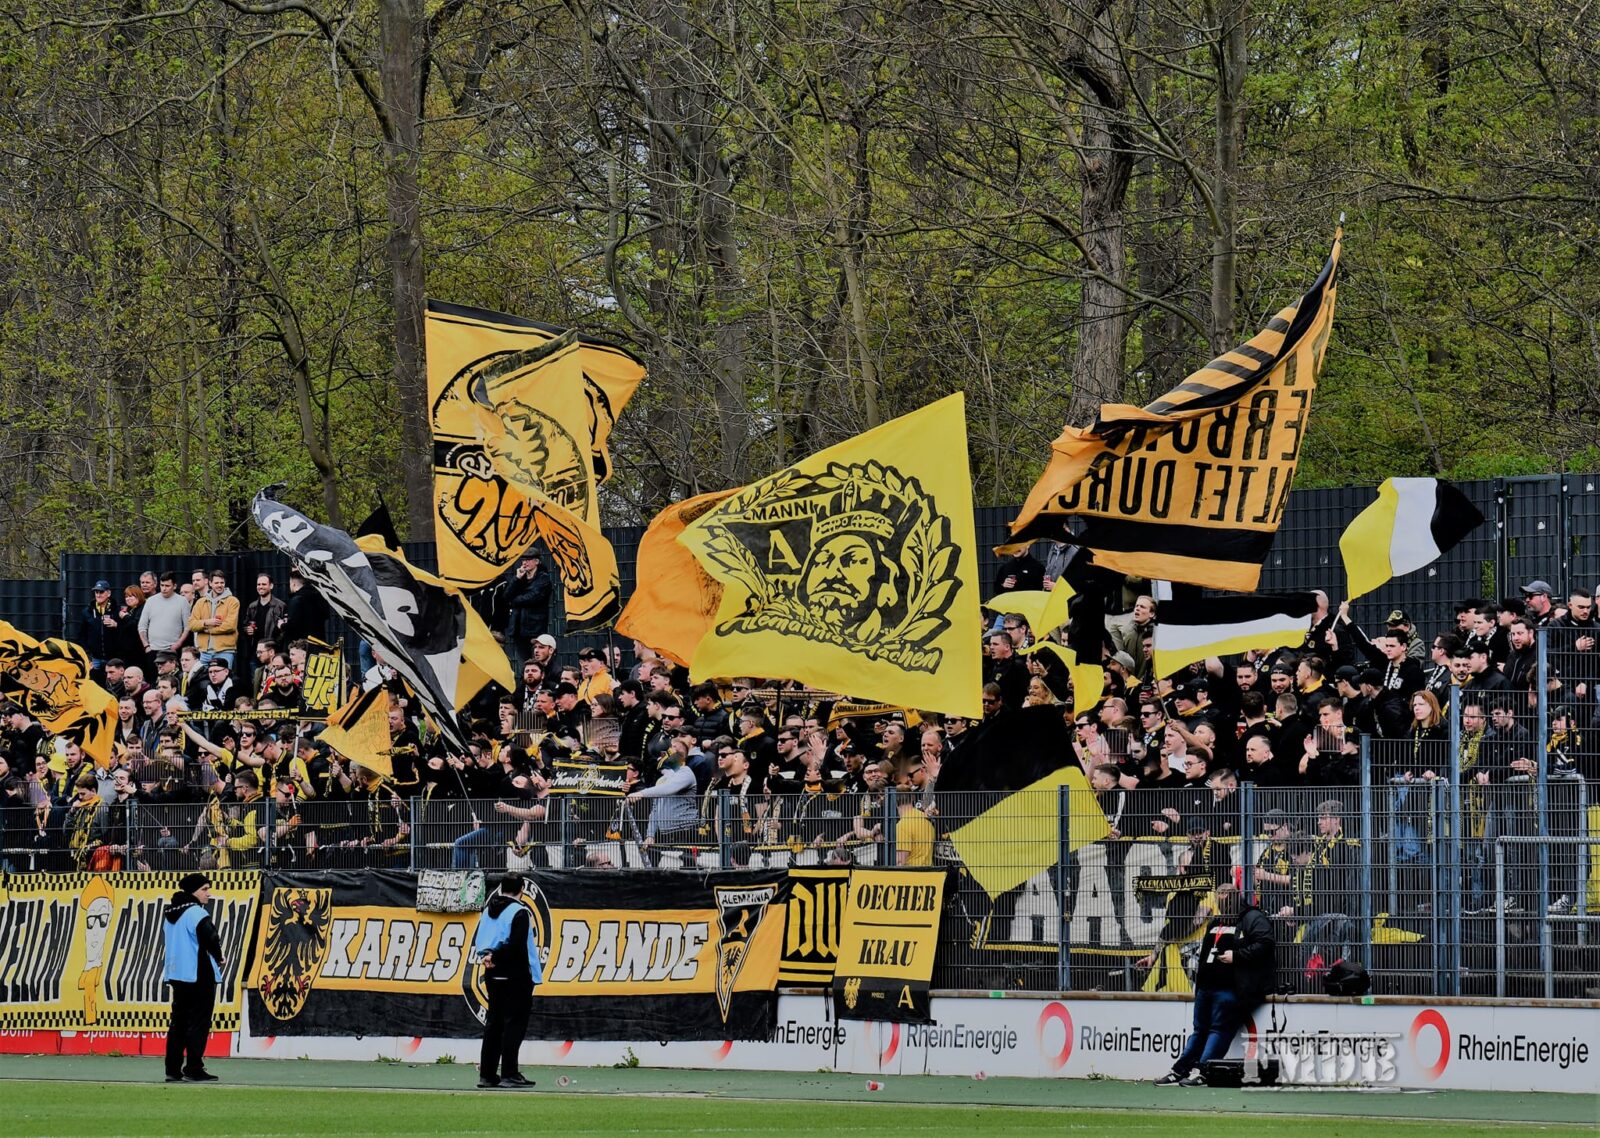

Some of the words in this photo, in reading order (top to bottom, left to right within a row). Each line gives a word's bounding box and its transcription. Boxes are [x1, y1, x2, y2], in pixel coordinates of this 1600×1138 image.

[768, 529, 802, 570] A
[857, 883, 936, 911] OECHER
[320, 918, 467, 982] KARLS
[549, 919, 709, 982] BANDE
[858, 939, 917, 966] KRAU
[898, 984, 914, 1009] A
[906, 1023, 1018, 1055] RheinEnergie
[1080, 1025, 1187, 1059] RheinEnergi
[1264, 1029, 1388, 1063] RheinEnergie
[1458, 1033, 1590, 1070] RheinEnergie
